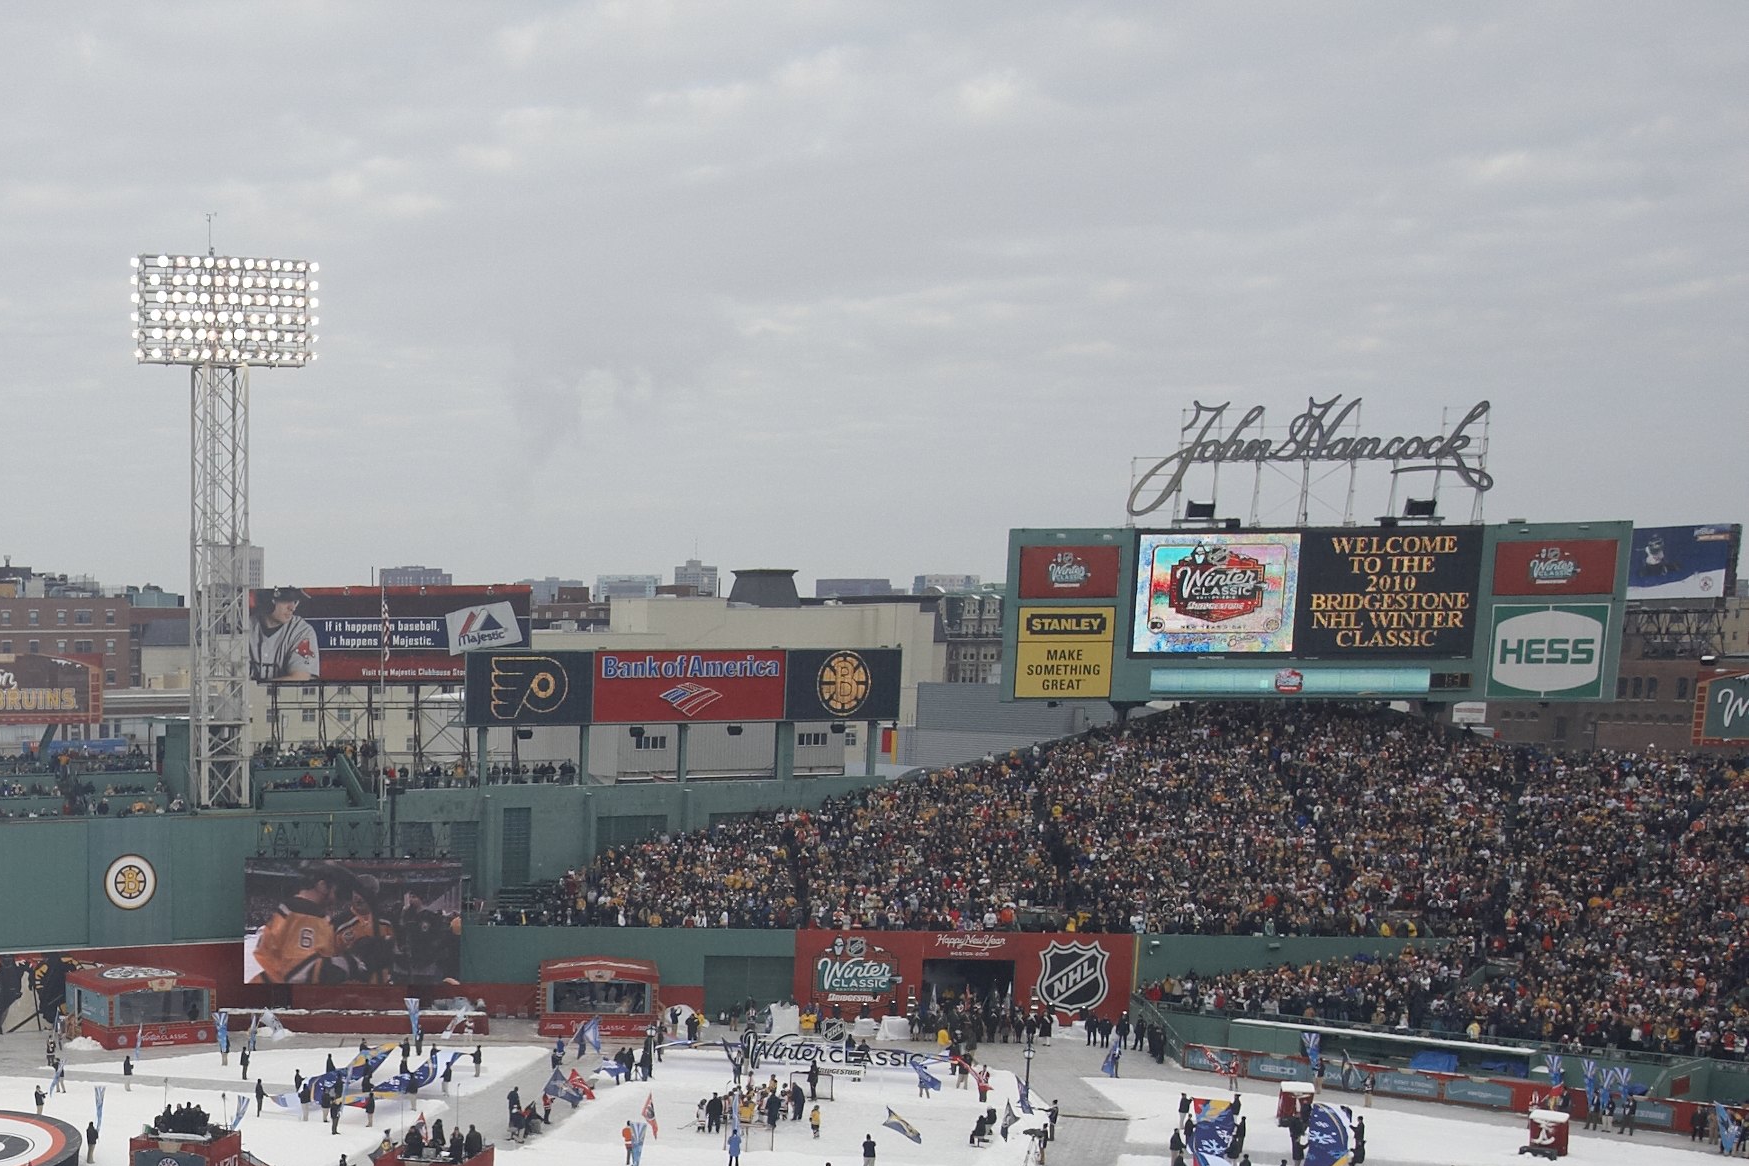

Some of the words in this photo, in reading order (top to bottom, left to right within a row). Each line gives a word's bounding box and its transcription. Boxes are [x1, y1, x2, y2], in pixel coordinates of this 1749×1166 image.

[1127, 400, 1271, 517] John
[1273, 394, 1494, 491] Hancock
[1331, 535, 1458, 554] WELCOME
[1049, 563, 1086, 581] Winter
[1349, 556, 1382, 574] TO
[1387, 555, 1435, 574] THE
[1530, 559, 1575, 578] Winter
[1176, 566, 1257, 598] Winter
[1191, 586, 1252, 597] CLASSIC
[1365, 574, 1416, 592] 2010
[1310, 592, 1470, 611] BRIDGESTONE
[325, 621, 333, 632] If
[335, 621, 343, 632] it
[345, 621, 383, 633] happens
[398, 620, 440, 633] baseball,
[1032, 618, 1102, 631] STANLEY
[1311, 611, 1364, 629] NHL
[1370, 610, 1464, 629] WINTER
[330, 635, 337, 646] it
[339, 635, 378, 648] happens
[393, 635, 435, 648] Majestic.
[458, 629, 505, 648] Majestic
[1336, 629, 1438, 648] CLASSIC
[1047, 650, 1083, 661] MAKE
[1499, 638, 1595, 665] HESS
[362, 668, 376, 676] Visit
[390, 668, 417, 677] Majestic
[418, 668, 451, 676] Clubhouse
[602, 656, 659, 679] Bank
[661, 655, 686, 677] of
[688, 656, 780, 678] America
[1027, 664, 1100, 676] SOMETHING
[1042, 679, 1082, 690] GREAT
[299, 928, 314, 949] 6
[935, 934, 967, 949] Happy
[964, 934, 985, 945] New
[983, 934, 1006, 951] Year
[817, 957, 892, 992] Winter
[832, 977, 887, 989] CLASSIC
[1053, 960, 1095, 998] NHL
[742, 1031, 826, 1069] Winter
[1259, 1064, 1296, 1076] GEICO
